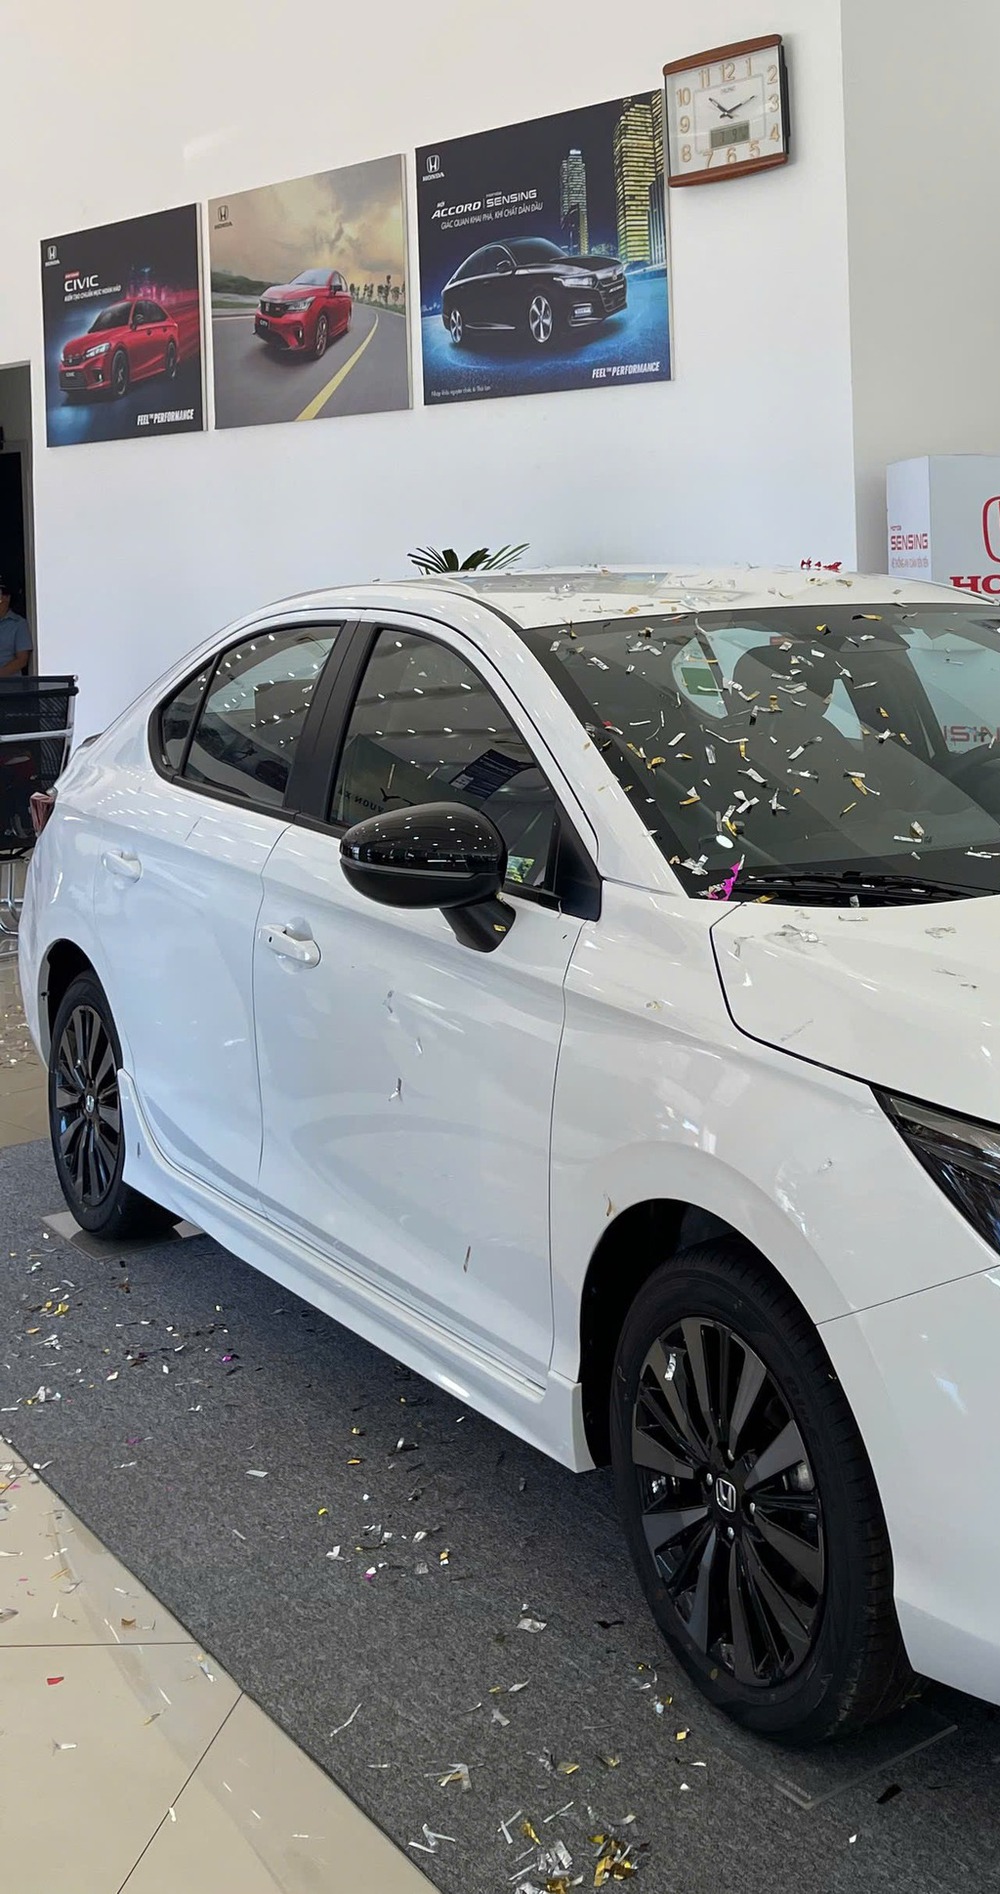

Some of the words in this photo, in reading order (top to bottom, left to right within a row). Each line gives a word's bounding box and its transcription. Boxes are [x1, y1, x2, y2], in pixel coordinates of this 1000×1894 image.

[722, 62, 735, 82] 12
[745, 57, 752, 76] 1
[767, 64, 778, 85] 2
[699, 67, 710, 88] 11
[676, 87, 691, 107] 10
[768, 93, 779, 112] 3
[680, 115, 690, 133] 9
[770, 122, 779, 142] 4
[681, 144, 692, 162] 8
[703, 148, 714, 169] 7
[727, 146, 737, 164] 6
[749, 140, 760, 158] 5
[431, 201, 481, 219] ACCORD
[486, 189, 537, 208] SENSING
[64, 274, 99, 292] CIVIC
[591, 368, 606, 379] FEEL
[611, 361, 660, 377] PERFORMANCE
[891, 533, 929, 551] SENSING
